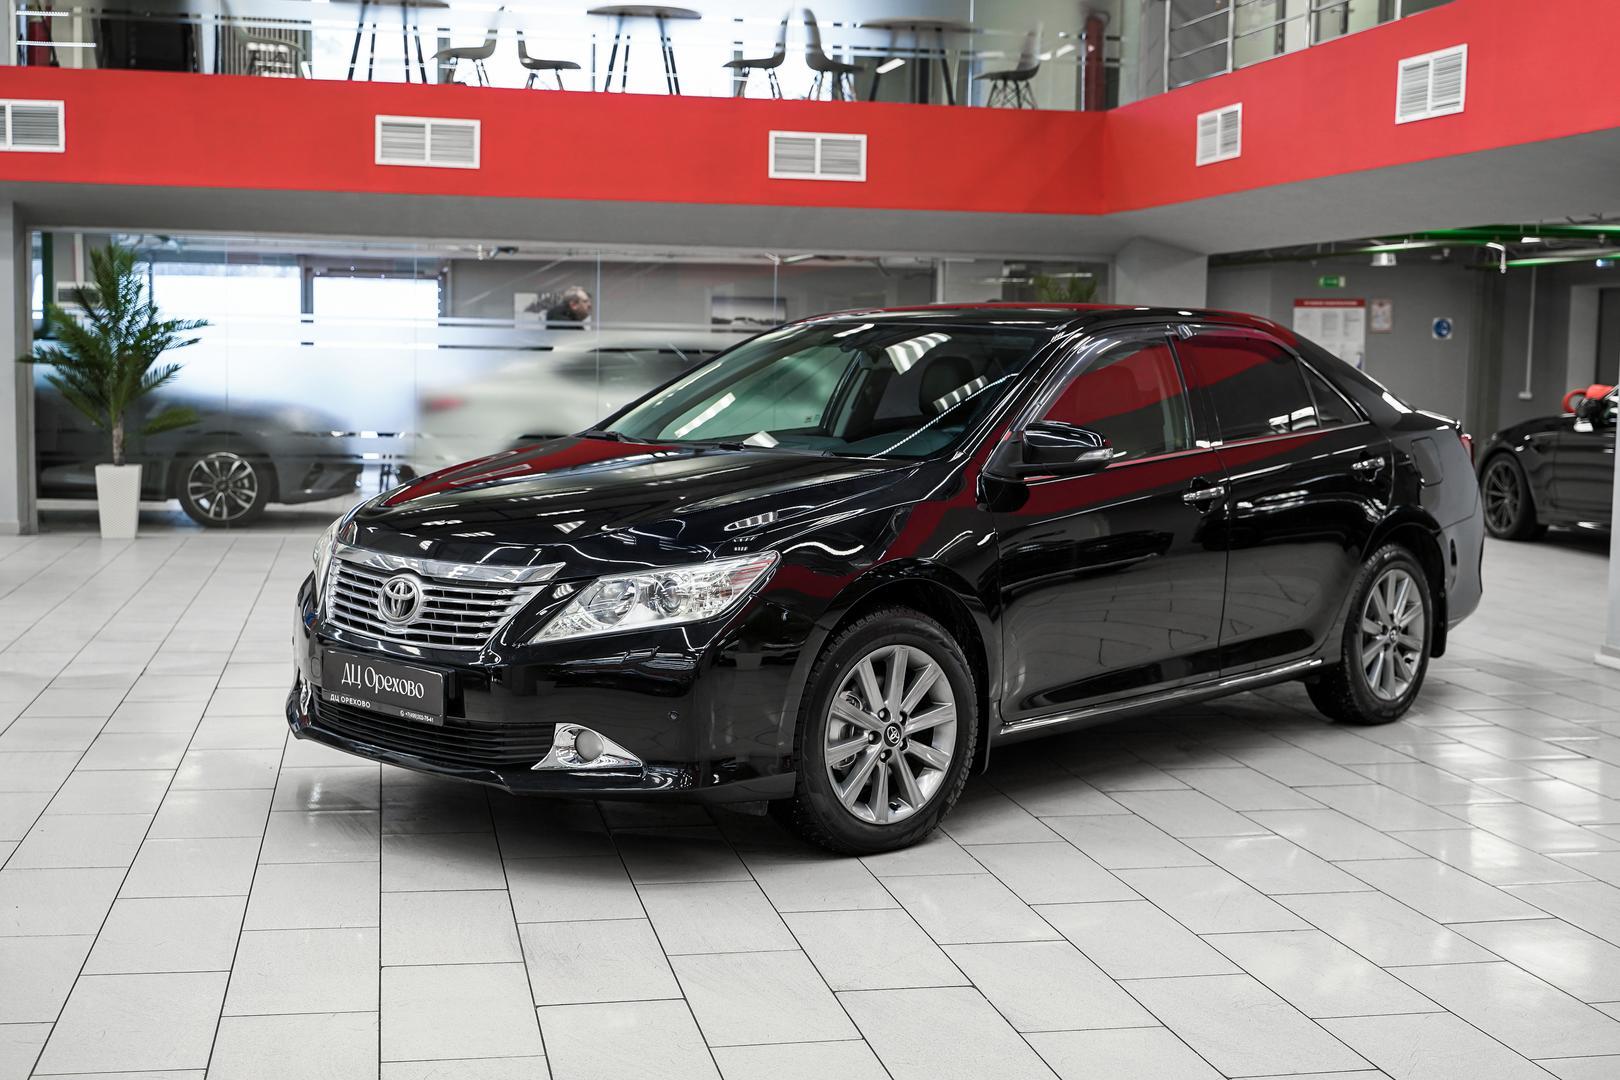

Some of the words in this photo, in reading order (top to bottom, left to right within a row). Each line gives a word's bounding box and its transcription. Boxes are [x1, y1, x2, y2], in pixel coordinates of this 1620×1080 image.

[341, 662, 362, 689] ДЦ
[364, 666, 425, 699] Орехово
[330, 693, 340, 703] ДЦ
[340, 696, 371, 709] ОРЕХОВО
